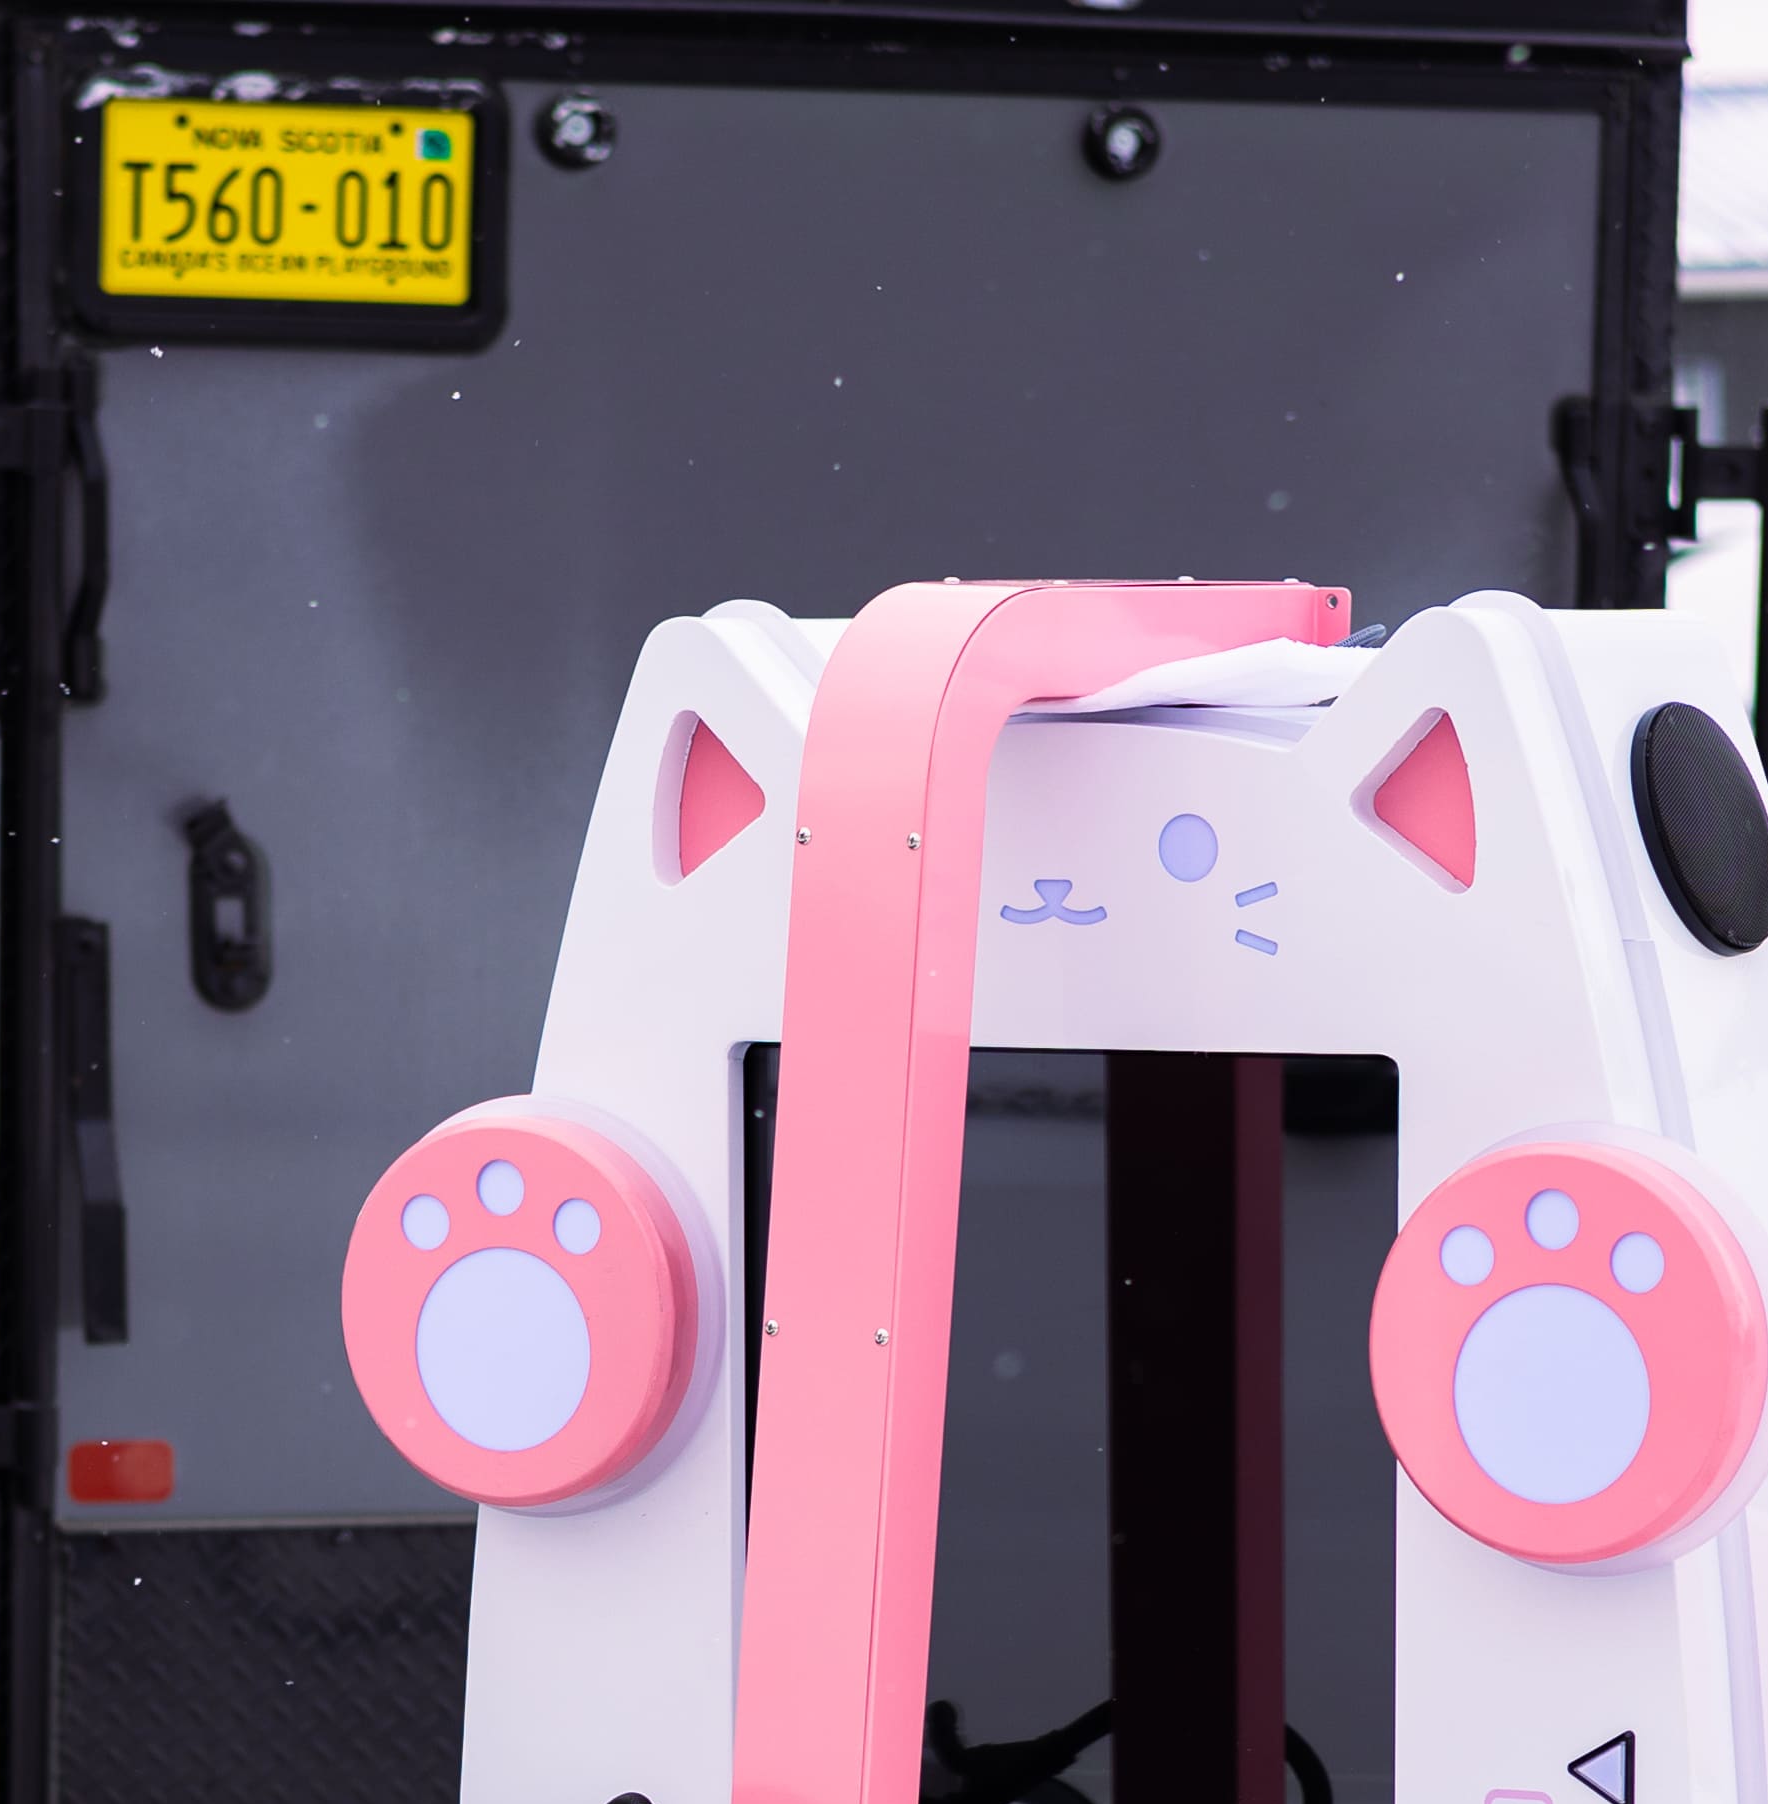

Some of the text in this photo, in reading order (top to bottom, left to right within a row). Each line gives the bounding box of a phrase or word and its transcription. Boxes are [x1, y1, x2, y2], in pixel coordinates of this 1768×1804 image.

[193, 128, 383, 155] NOVA SCOTIA
[122, 161, 455, 252] T560-010
[237, 253, 308, 273] OCEAN
[315, 255, 452, 279] PLAYGROUND
